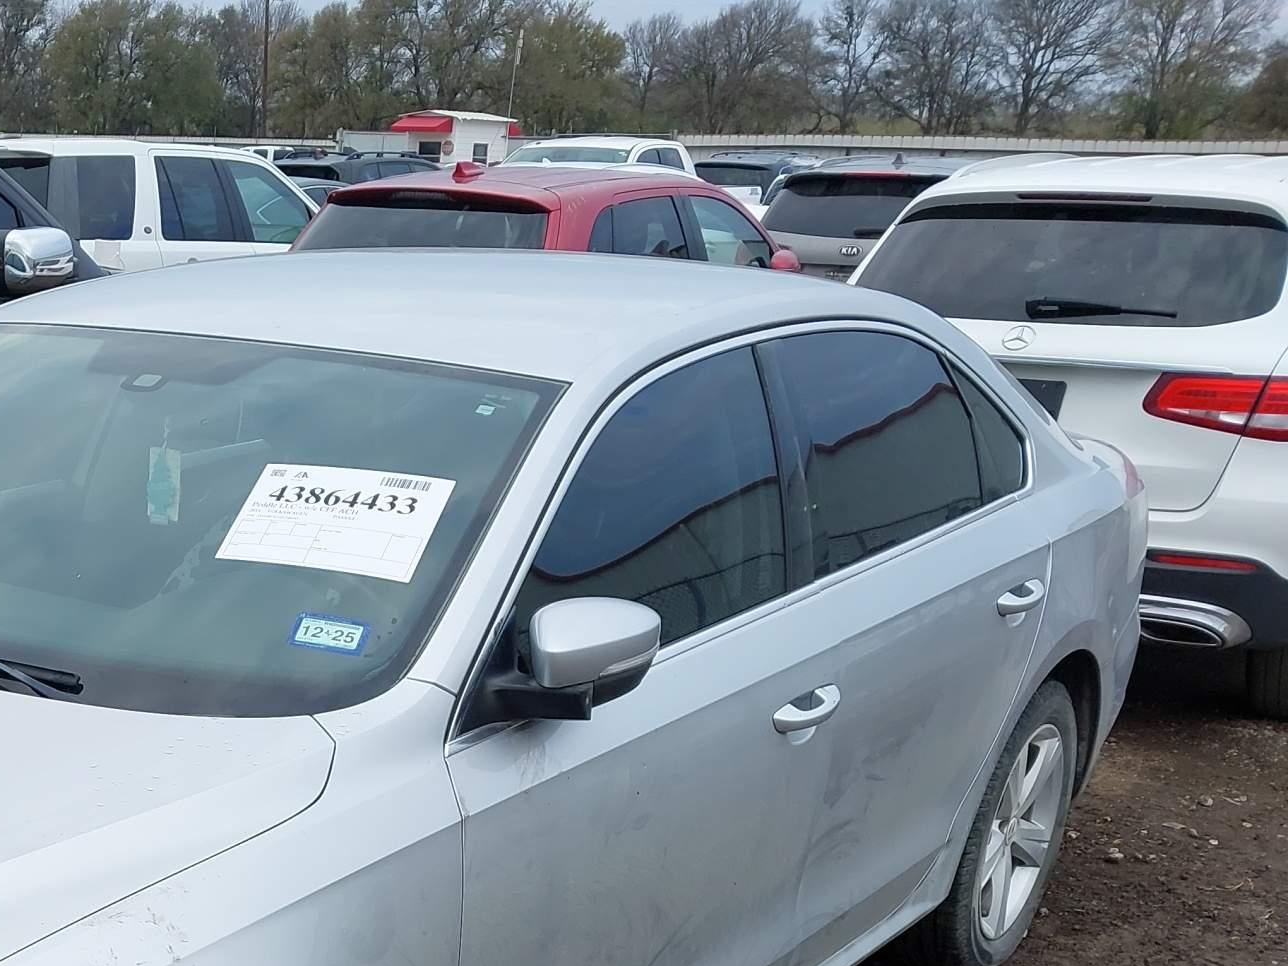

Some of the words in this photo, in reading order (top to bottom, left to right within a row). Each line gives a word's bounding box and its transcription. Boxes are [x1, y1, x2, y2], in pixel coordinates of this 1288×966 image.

[840, 246, 859, 256] KIA
[268, 485, 418, 515] 43864433
[303, 625, 324, 638] 12
[330, 630, 357, 644] 25
